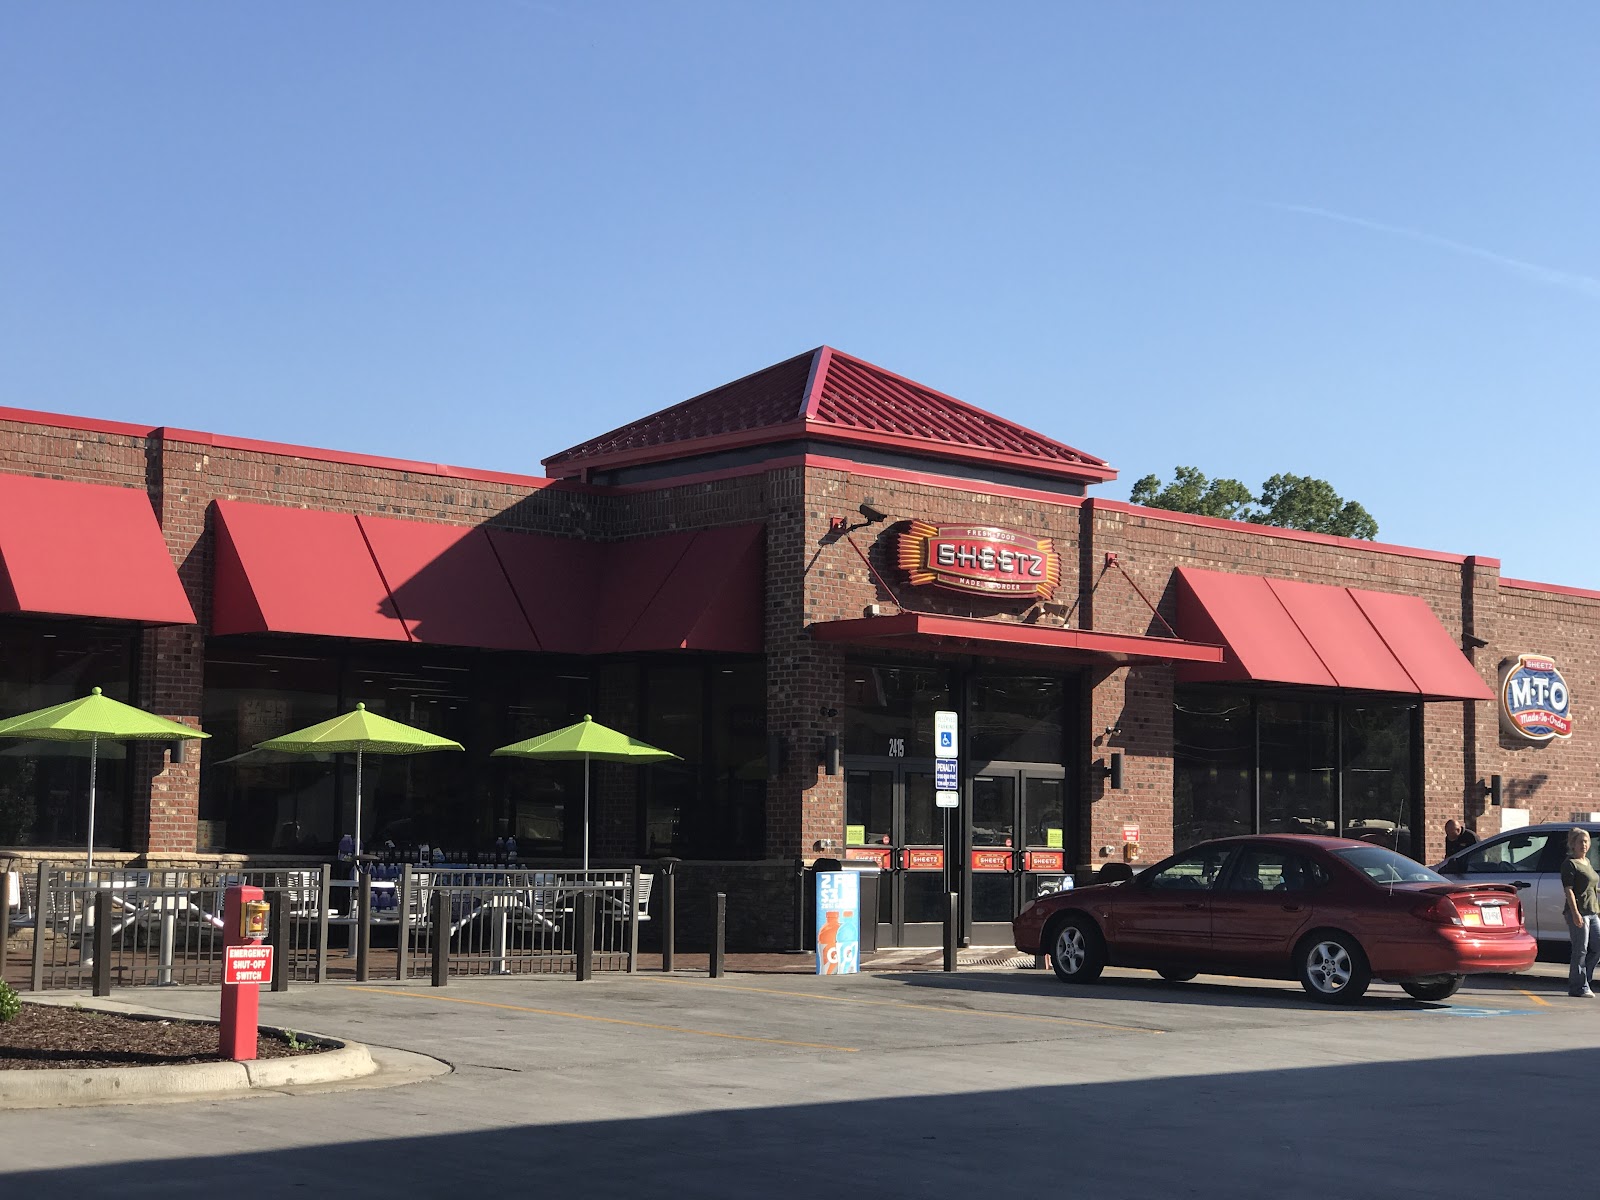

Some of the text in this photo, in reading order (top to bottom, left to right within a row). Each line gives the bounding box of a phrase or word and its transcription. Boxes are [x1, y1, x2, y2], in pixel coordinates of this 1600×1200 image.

[967, 529, 1015, 541] FRESH FOOD
[938, 544, 1043, 576] SHEETZ
[959, 577, 981, 587] MADE
[1527, 661, 1553, 669] SHEETZ
[888, 738, 904, 757] 2415
[937, 763, 956, 773] PENALTY
[821, 874, 831, 888] 2
[230, 949, 270, 958] EMERGENCY
[233, 960, 266, 969] SHUT-OFF
[236, 971, 262, 980] SWITCH
